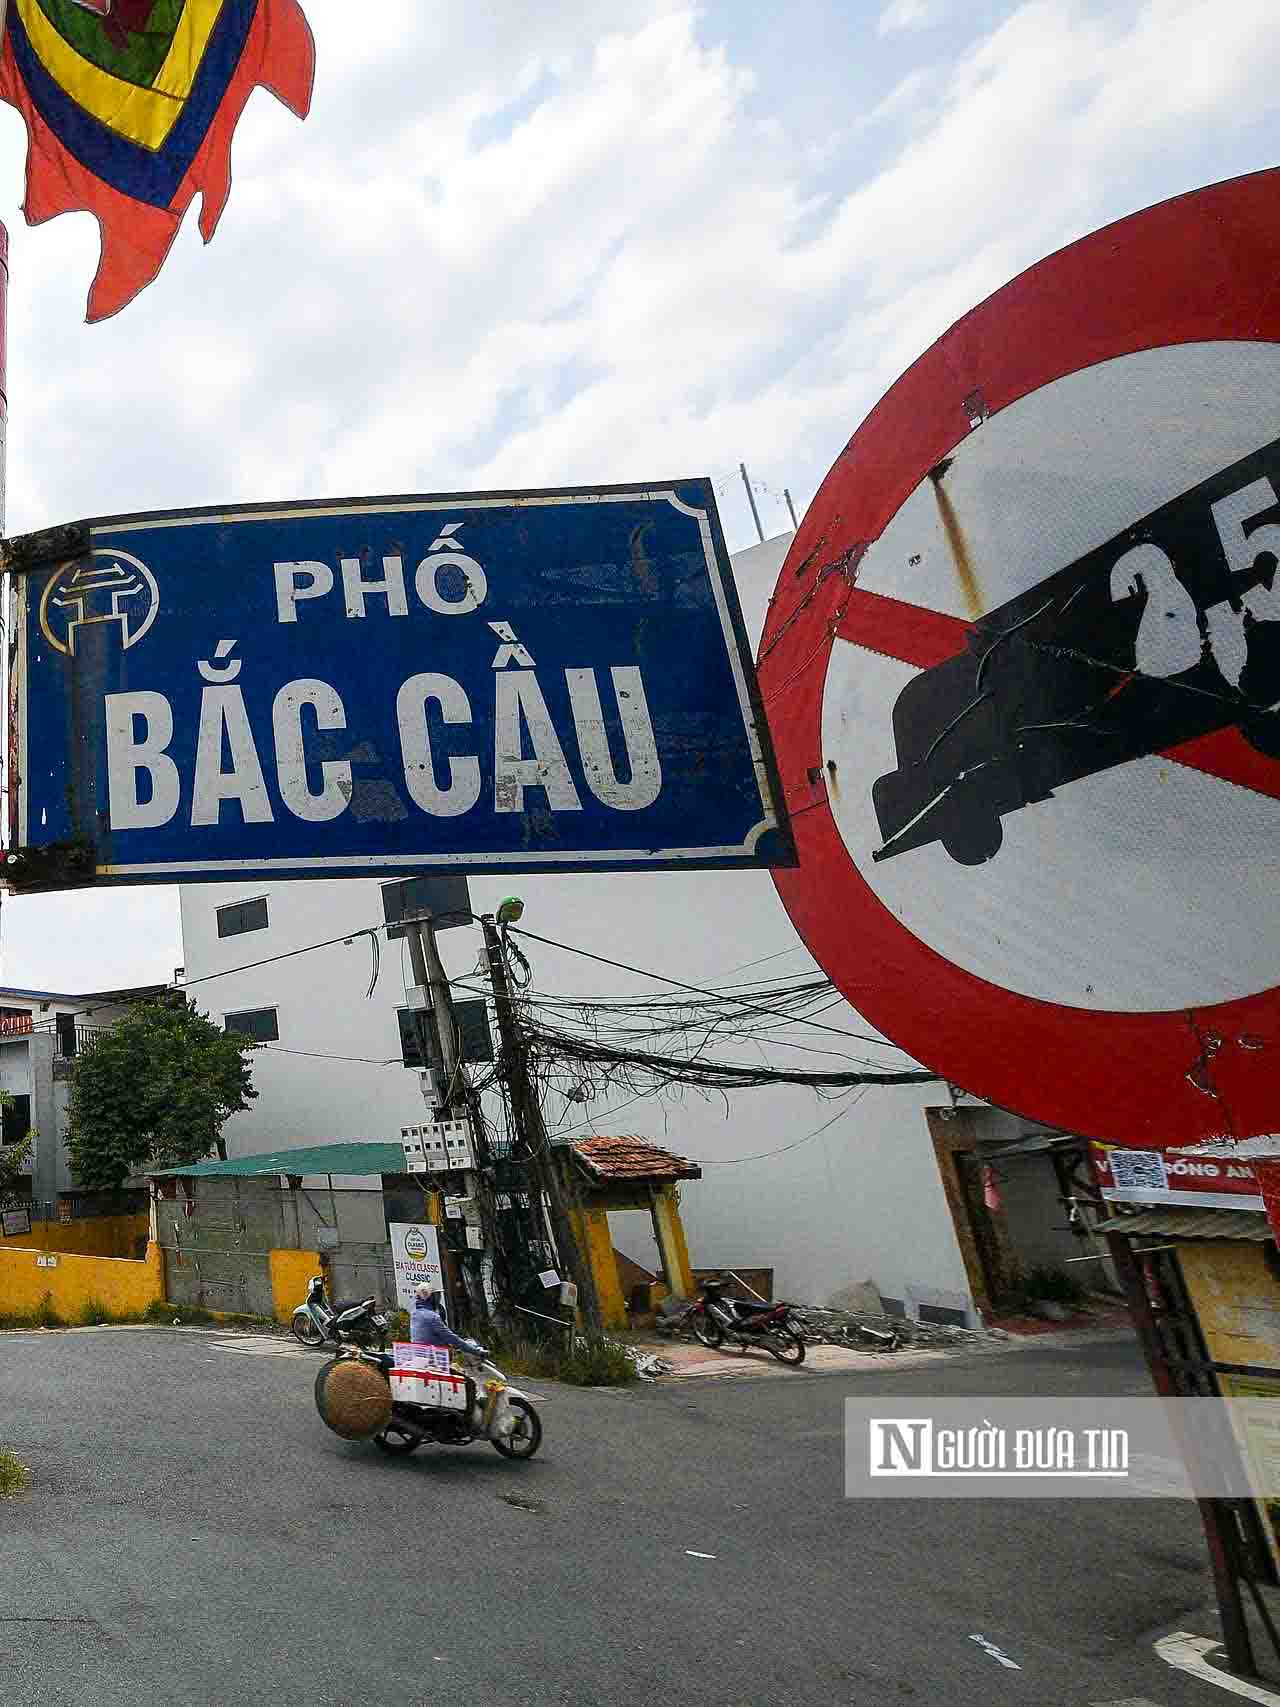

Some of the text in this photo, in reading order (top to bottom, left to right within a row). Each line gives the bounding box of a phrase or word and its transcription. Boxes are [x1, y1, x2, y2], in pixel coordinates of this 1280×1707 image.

[272, 522, 488, 623] PHỐ
[104, 621, 663, 831] BẮC CẦU
[405, 1272, 431, 1283] CLASSIC
